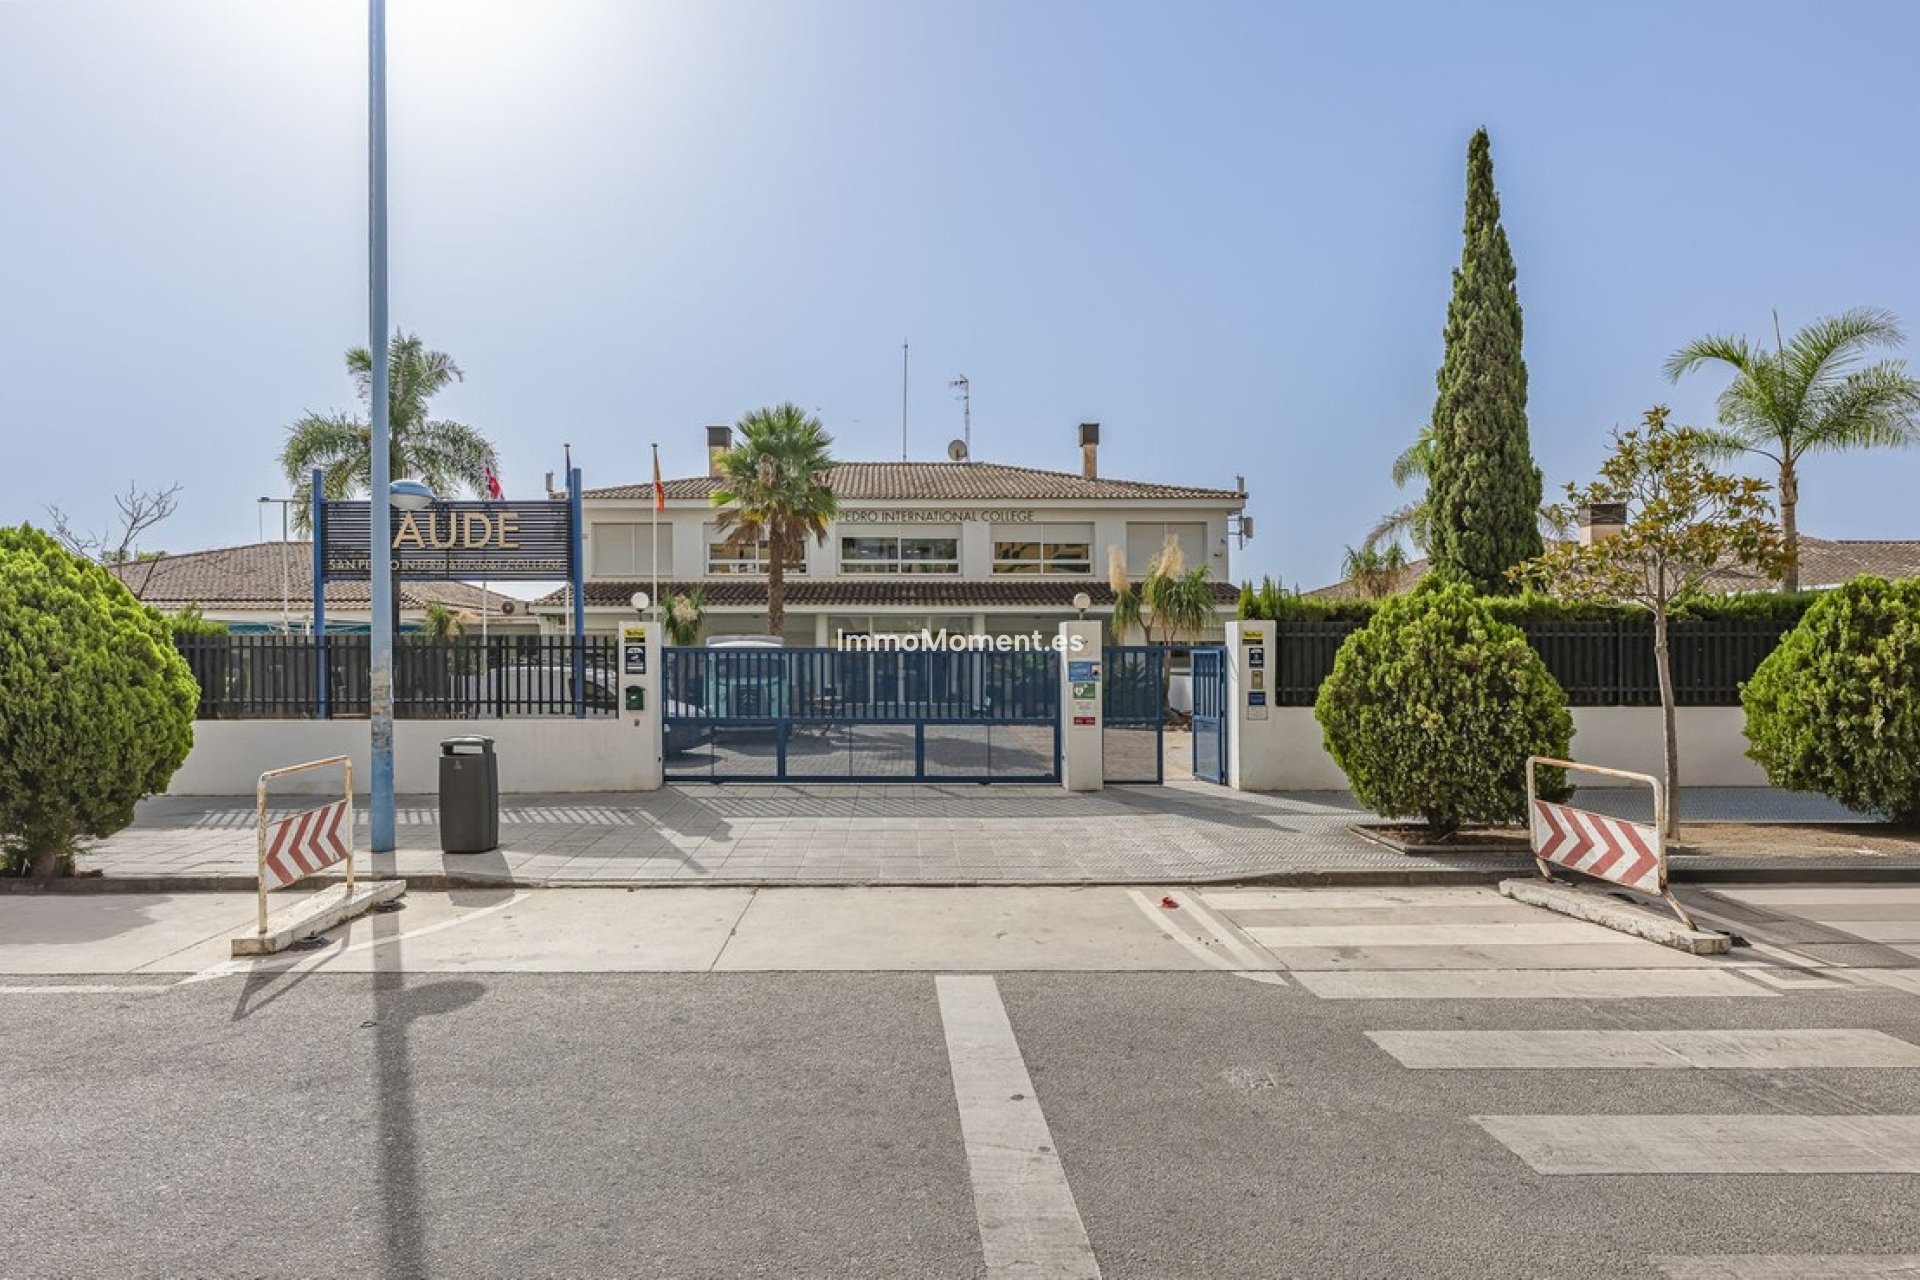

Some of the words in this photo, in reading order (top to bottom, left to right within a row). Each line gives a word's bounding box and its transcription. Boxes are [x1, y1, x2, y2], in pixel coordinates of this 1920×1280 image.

[838, 510, 878, 522] PEDRO
[881, 510, 977, 522] INTERNATIONAL
[980, 510, 1035, 522] COLLEGE
[329, 558, 357, 571] SAN
[358, 558, 400, 571] PEO
